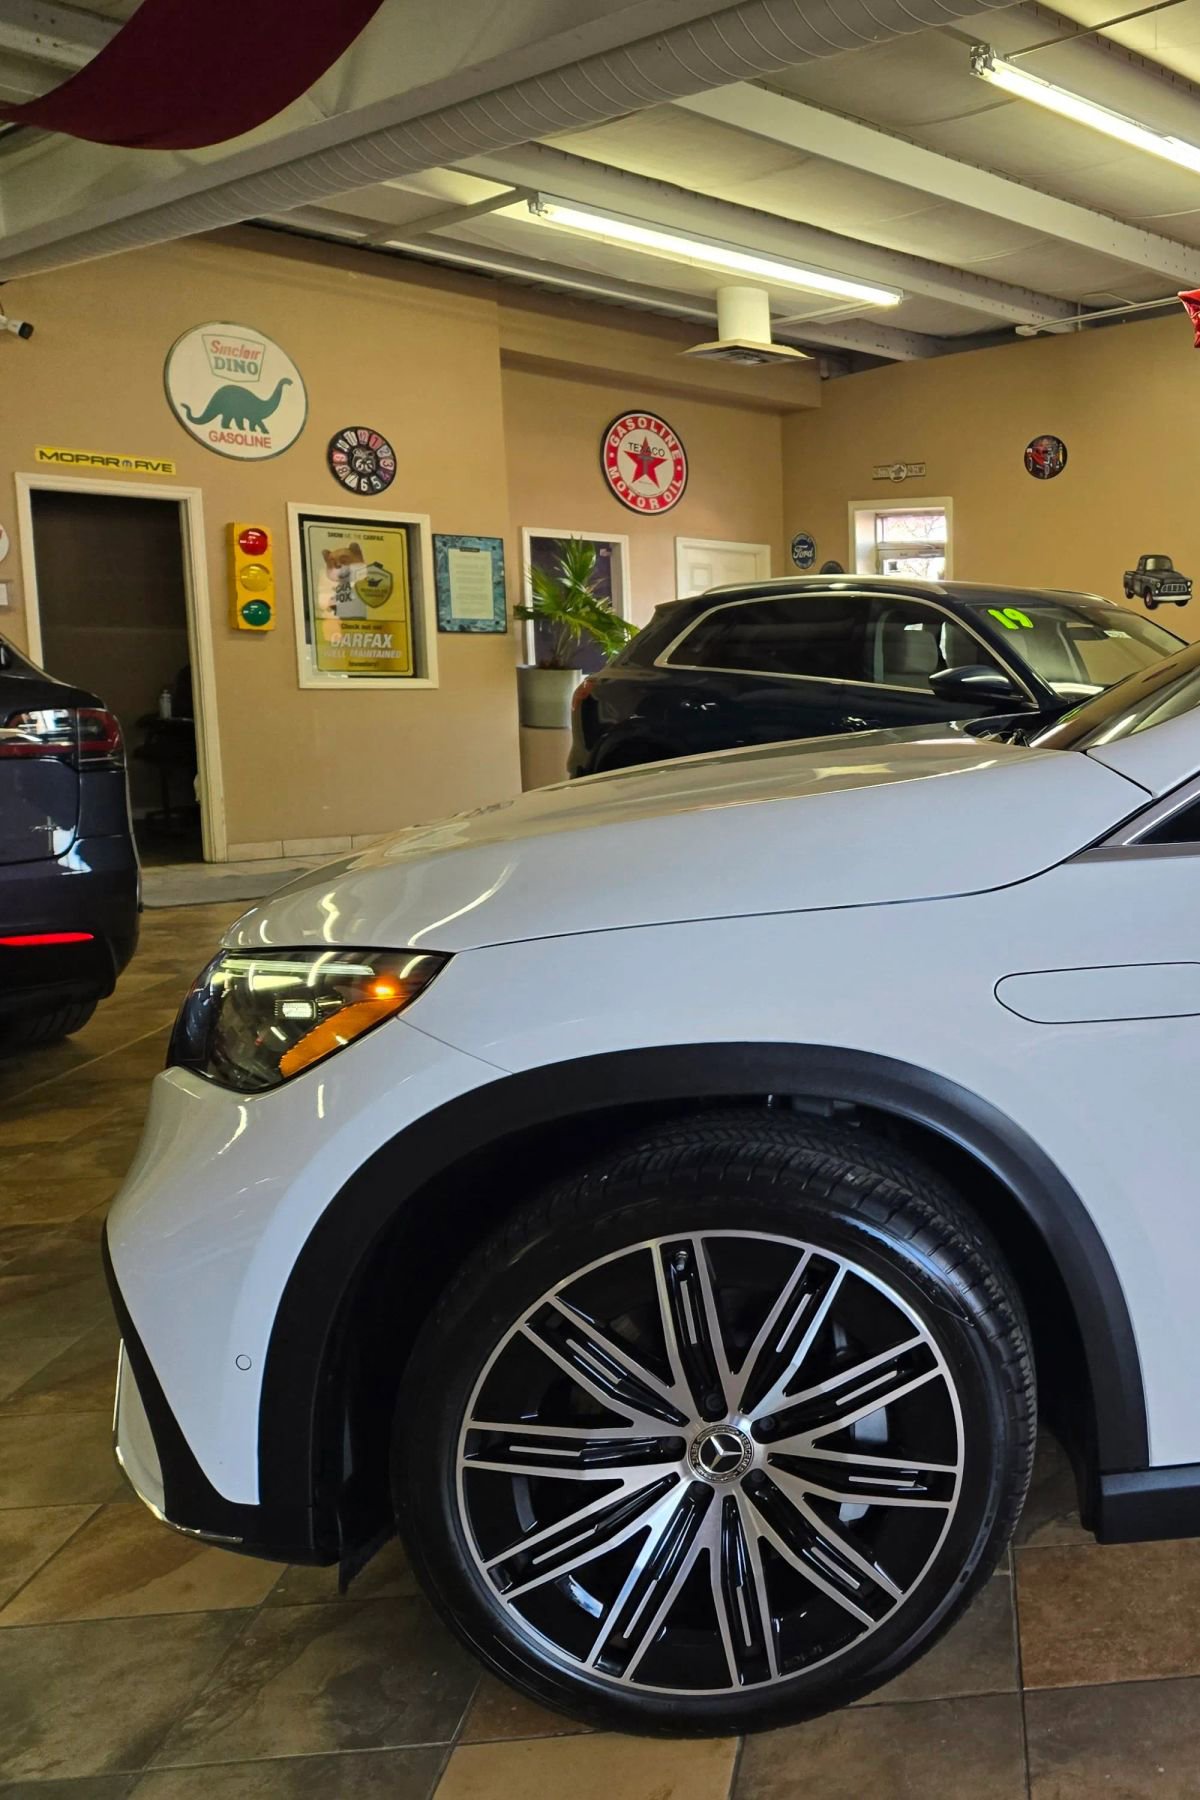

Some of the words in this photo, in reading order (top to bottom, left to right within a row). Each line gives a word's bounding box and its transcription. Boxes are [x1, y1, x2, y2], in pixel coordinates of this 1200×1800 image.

[210, 340, 261, 360] Sinclair
[213, 356, 259, 375] DINO
[208, 430, 272, 448] GASOLINE
[609, 417, 683, 460] GASOLINE
[628, 442, 665, 457] TEXACO
[39, 450, 119, 467] MOPAR
[135, 460, 172, 472] AVE
[609, 466, 660, 510] MOTOR
[663, 480, 682, 502] OIL
[793, 545, 813, 558] Ford
[988, 608, 1034, 630] 19
[331, 632, 392, 648] CARFAX
